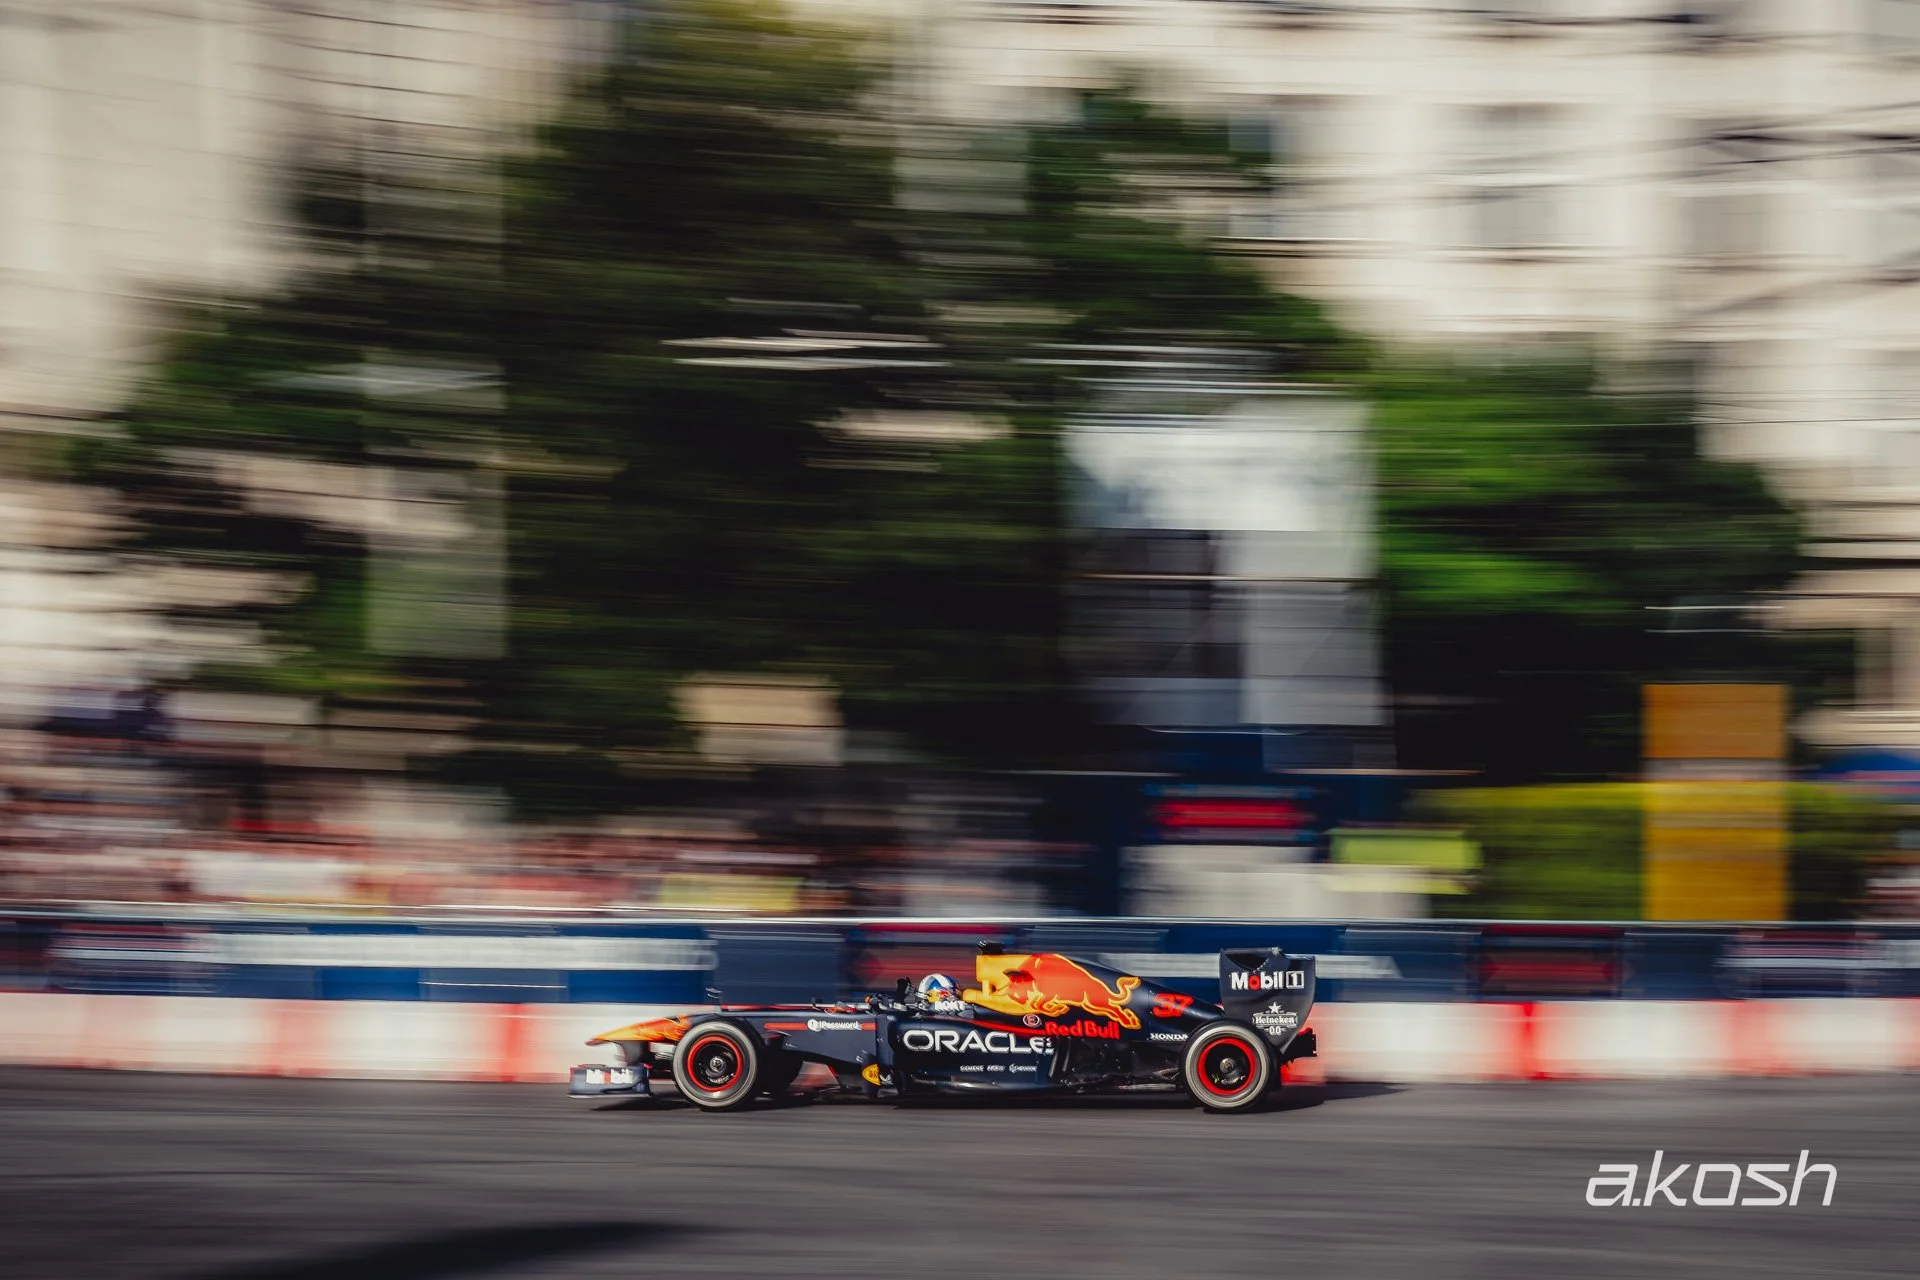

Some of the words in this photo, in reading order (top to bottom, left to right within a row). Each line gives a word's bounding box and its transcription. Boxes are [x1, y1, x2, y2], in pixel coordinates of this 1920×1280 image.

[1231, 971, 1283, 990] Mobil
[1288, 971, 1302, 989] 1
[1152, 993, 1194, 1018] 37
[1044, 1020, 1083, 1037] Red
[1084, 1020, 1119, 1039] Bull
[1255, 1015, 1295, 1025] Heineken
[903, 1029, 1054, 1055] ORACLE
[1150, 1033, 1189, 1041] HONDA
